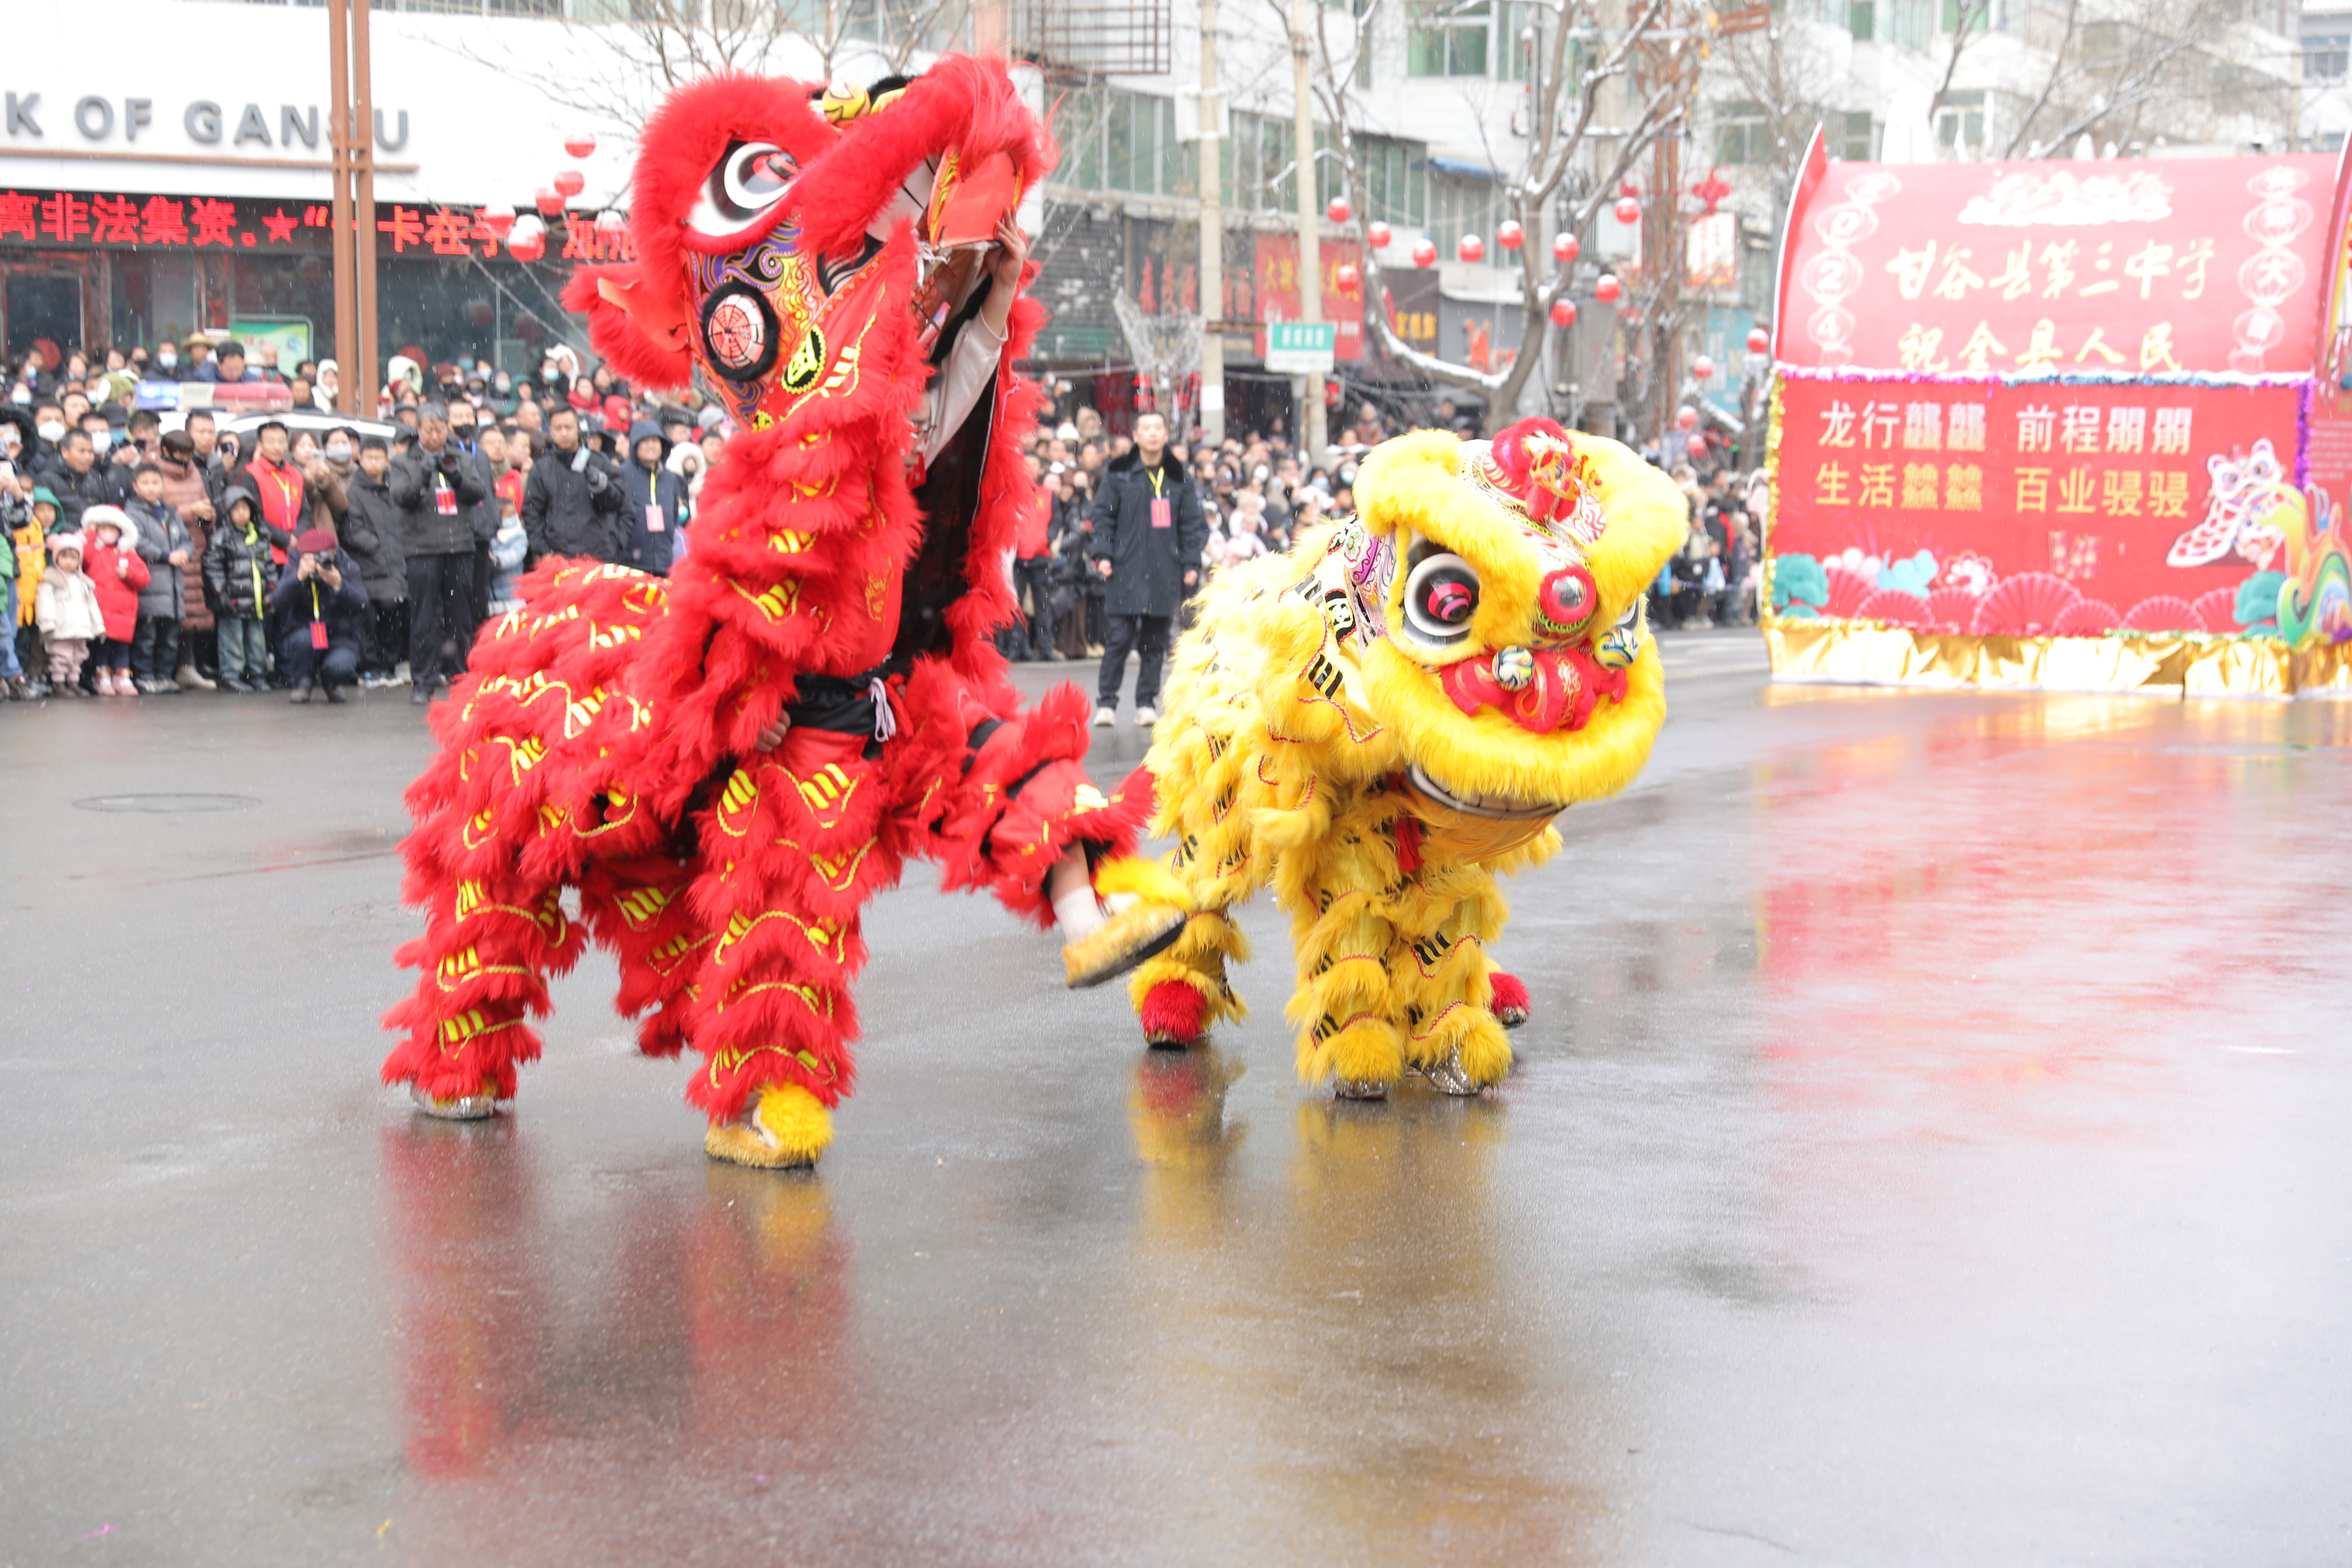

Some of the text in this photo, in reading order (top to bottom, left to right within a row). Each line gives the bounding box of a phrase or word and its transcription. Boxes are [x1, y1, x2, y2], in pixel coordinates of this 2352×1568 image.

[74, 94, 153, 141] OF
[183, 99, 408, 151] GANU
[1884, 237, 2215, 300] 甘谷县第三中学
[1898, 318, 2183, 372] 祝全县人民
[2014, 468, 2189, 518] 百业骎骎
